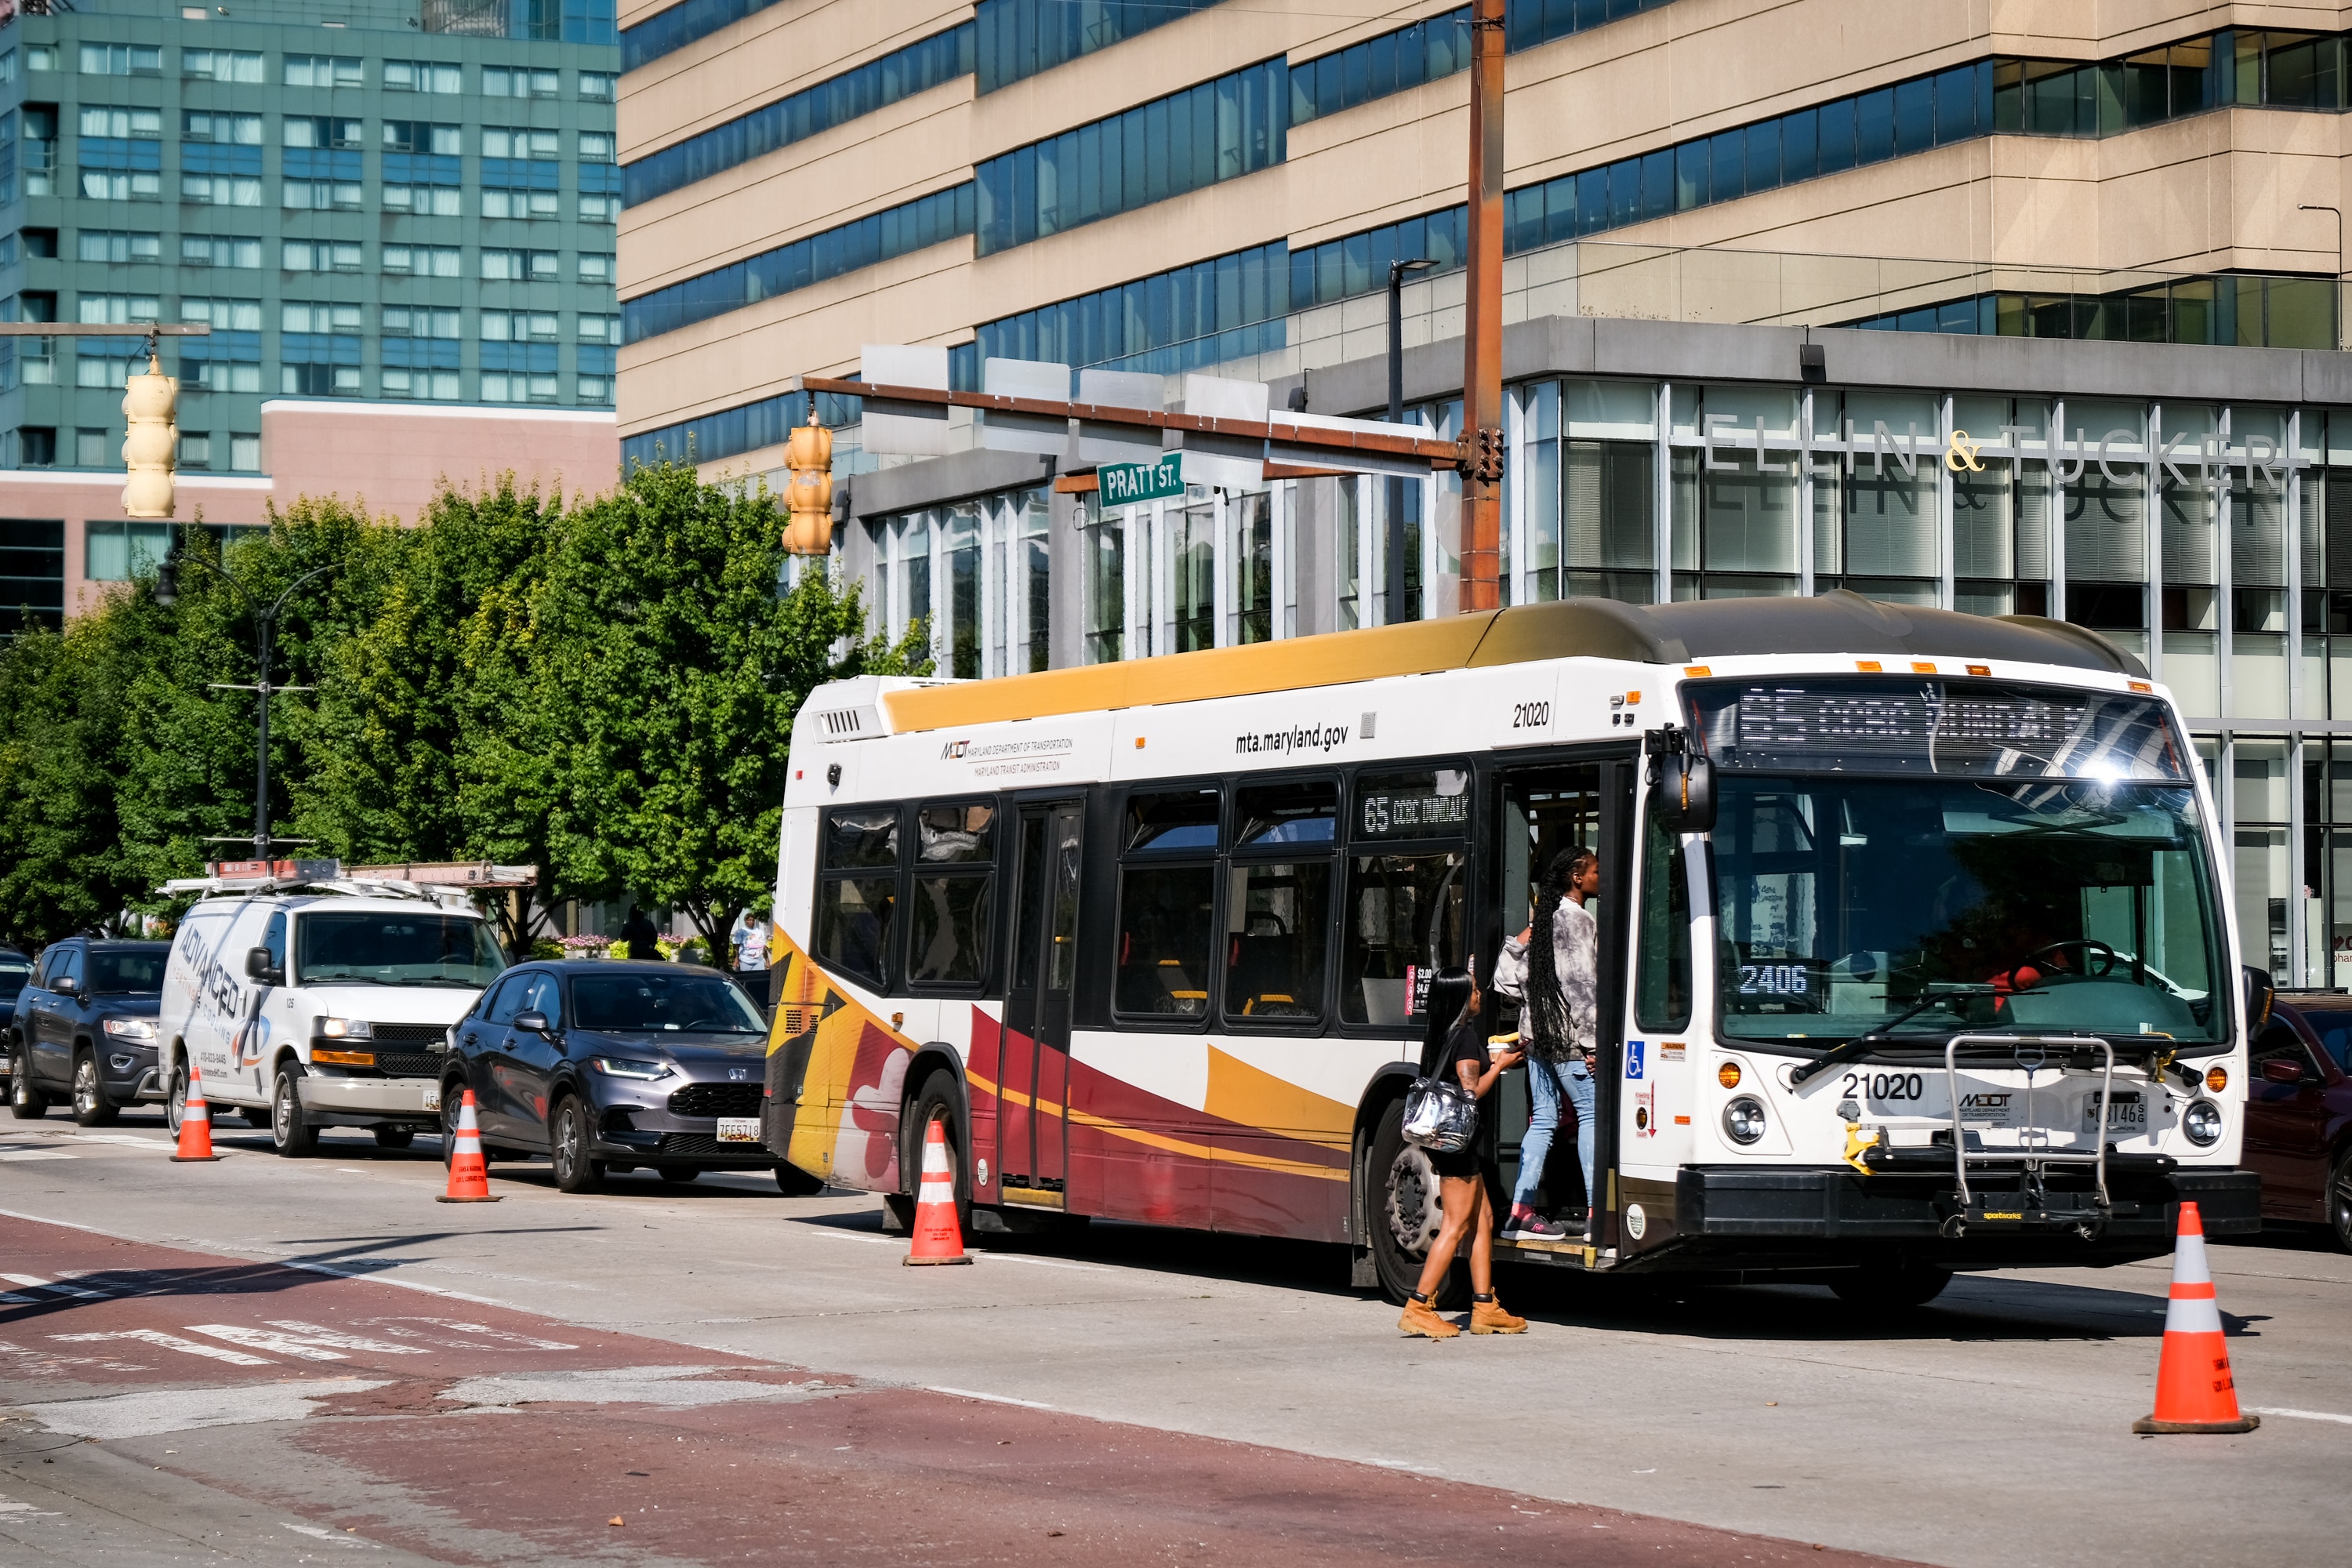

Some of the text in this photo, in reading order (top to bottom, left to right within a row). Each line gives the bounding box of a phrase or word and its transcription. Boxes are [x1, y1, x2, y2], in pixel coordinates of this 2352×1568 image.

[1705, 397, 2278, 489] ELLIN & TUCKER
[1106, 464, 1177, 499] PRATT ST.
[1512, 701, 1549, 728] 21020
[967, 746, 991, 757] MARYLAND
[992, 742, 1024, 755] DEPARTMENT
[1023, 742, 1030, 752] OF
[1031, 739, 1073, 750] TRANSPORTATION
[1236, 722, 1349, 755] mta.maryland.gov
[975, 760, 1060, 777] MARYLAND TRANSIT ADMINISTRATION
[1364, 797, 1388, 832] 65
[179, 923, 239, 1019] ADVANCED
[1417, 967, 1432, 980] $2.00
[1740, 965, 1806, 993] 2406
[286, 998, 295, 1009] 125
[203, 1003, 230, 1045] COOLING
[1842, 1073, 1922, 1101] 21020
